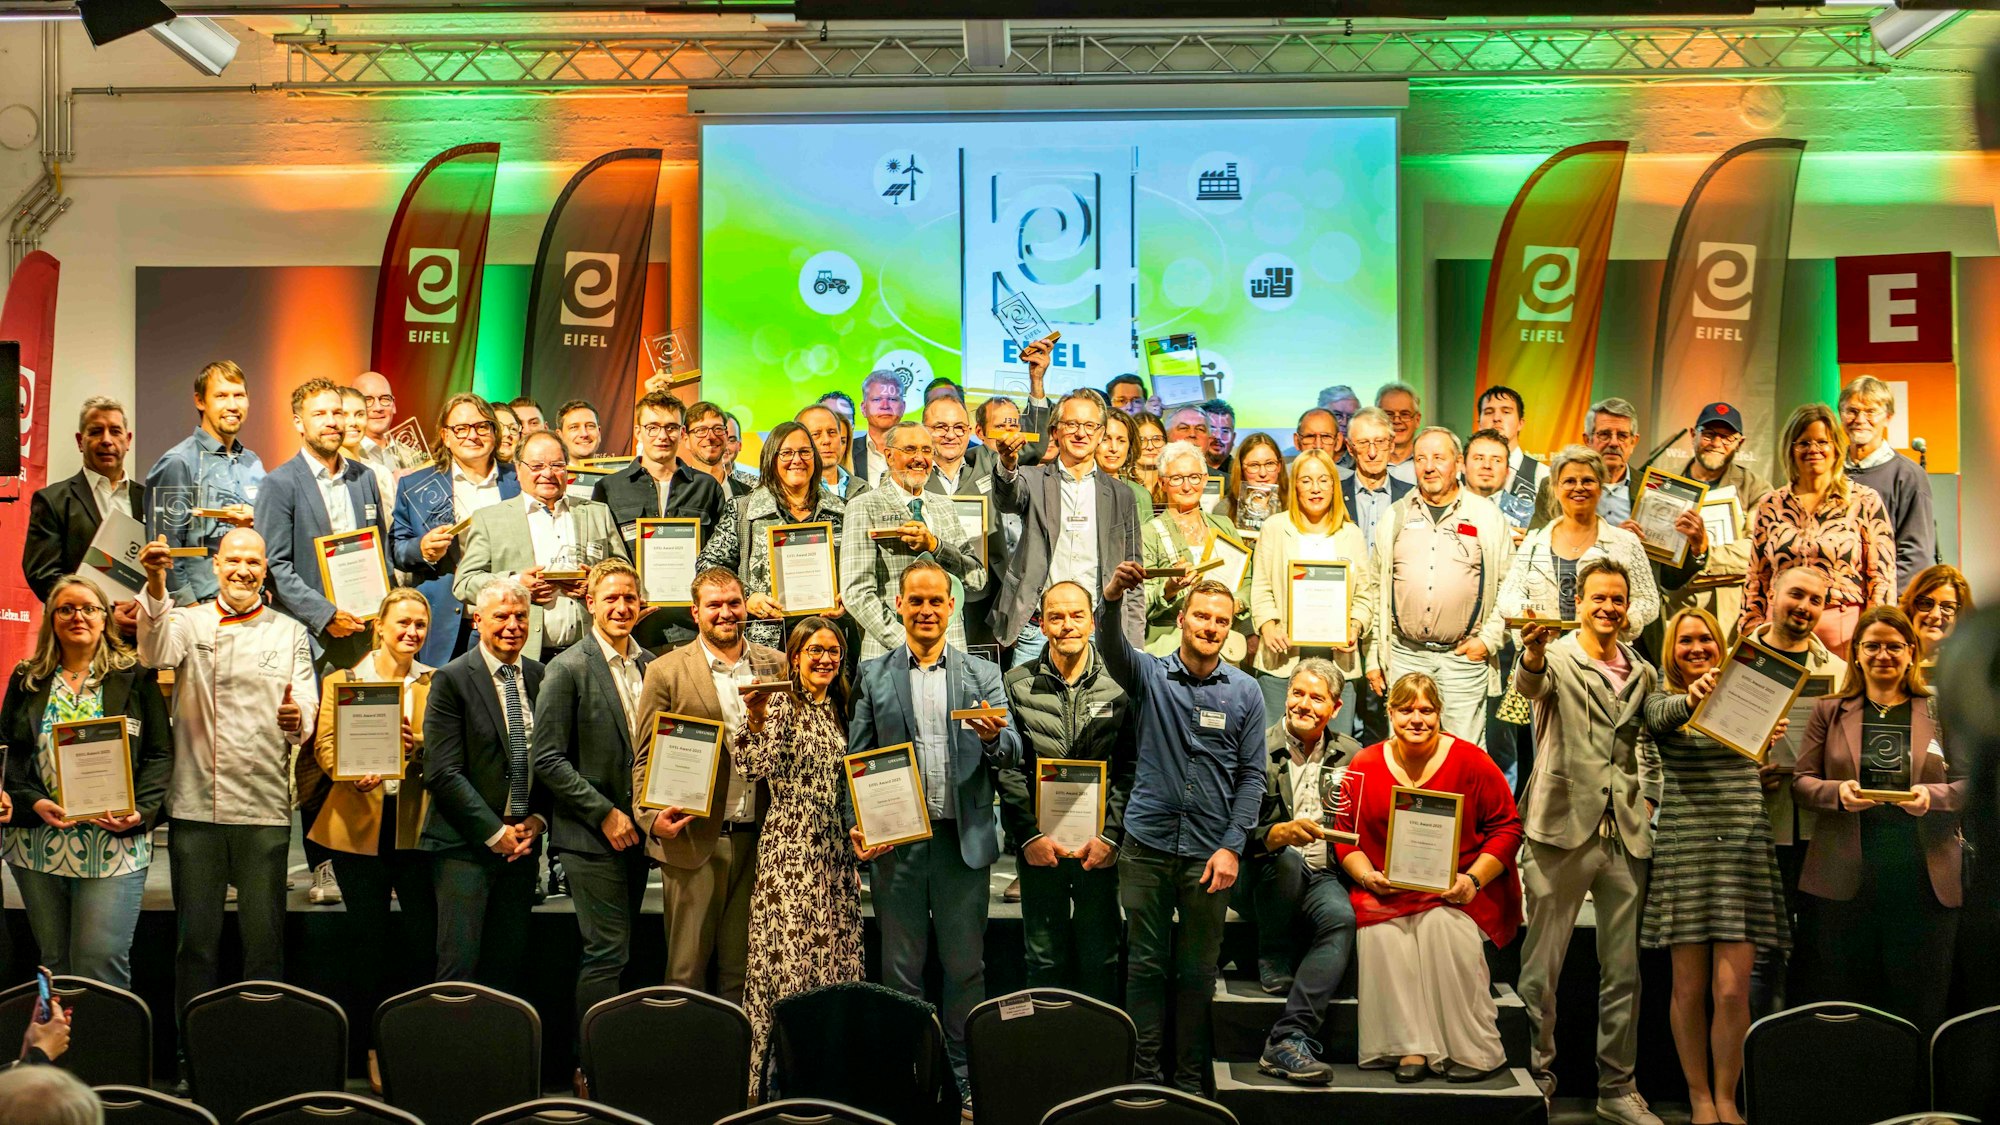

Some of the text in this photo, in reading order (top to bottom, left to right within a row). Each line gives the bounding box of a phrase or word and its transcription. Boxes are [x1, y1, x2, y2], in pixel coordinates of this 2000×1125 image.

[1868, 273, 1919, 343] E
[408, 330, 450, 344] EIFEL
[563, 333, 608, 348] EIFEL
[1024, 329, 1042, 341] EIFEL
[1519, 328, 1565, 344] EIFEL
[1695, 326, 1743, 342] EIFEL
